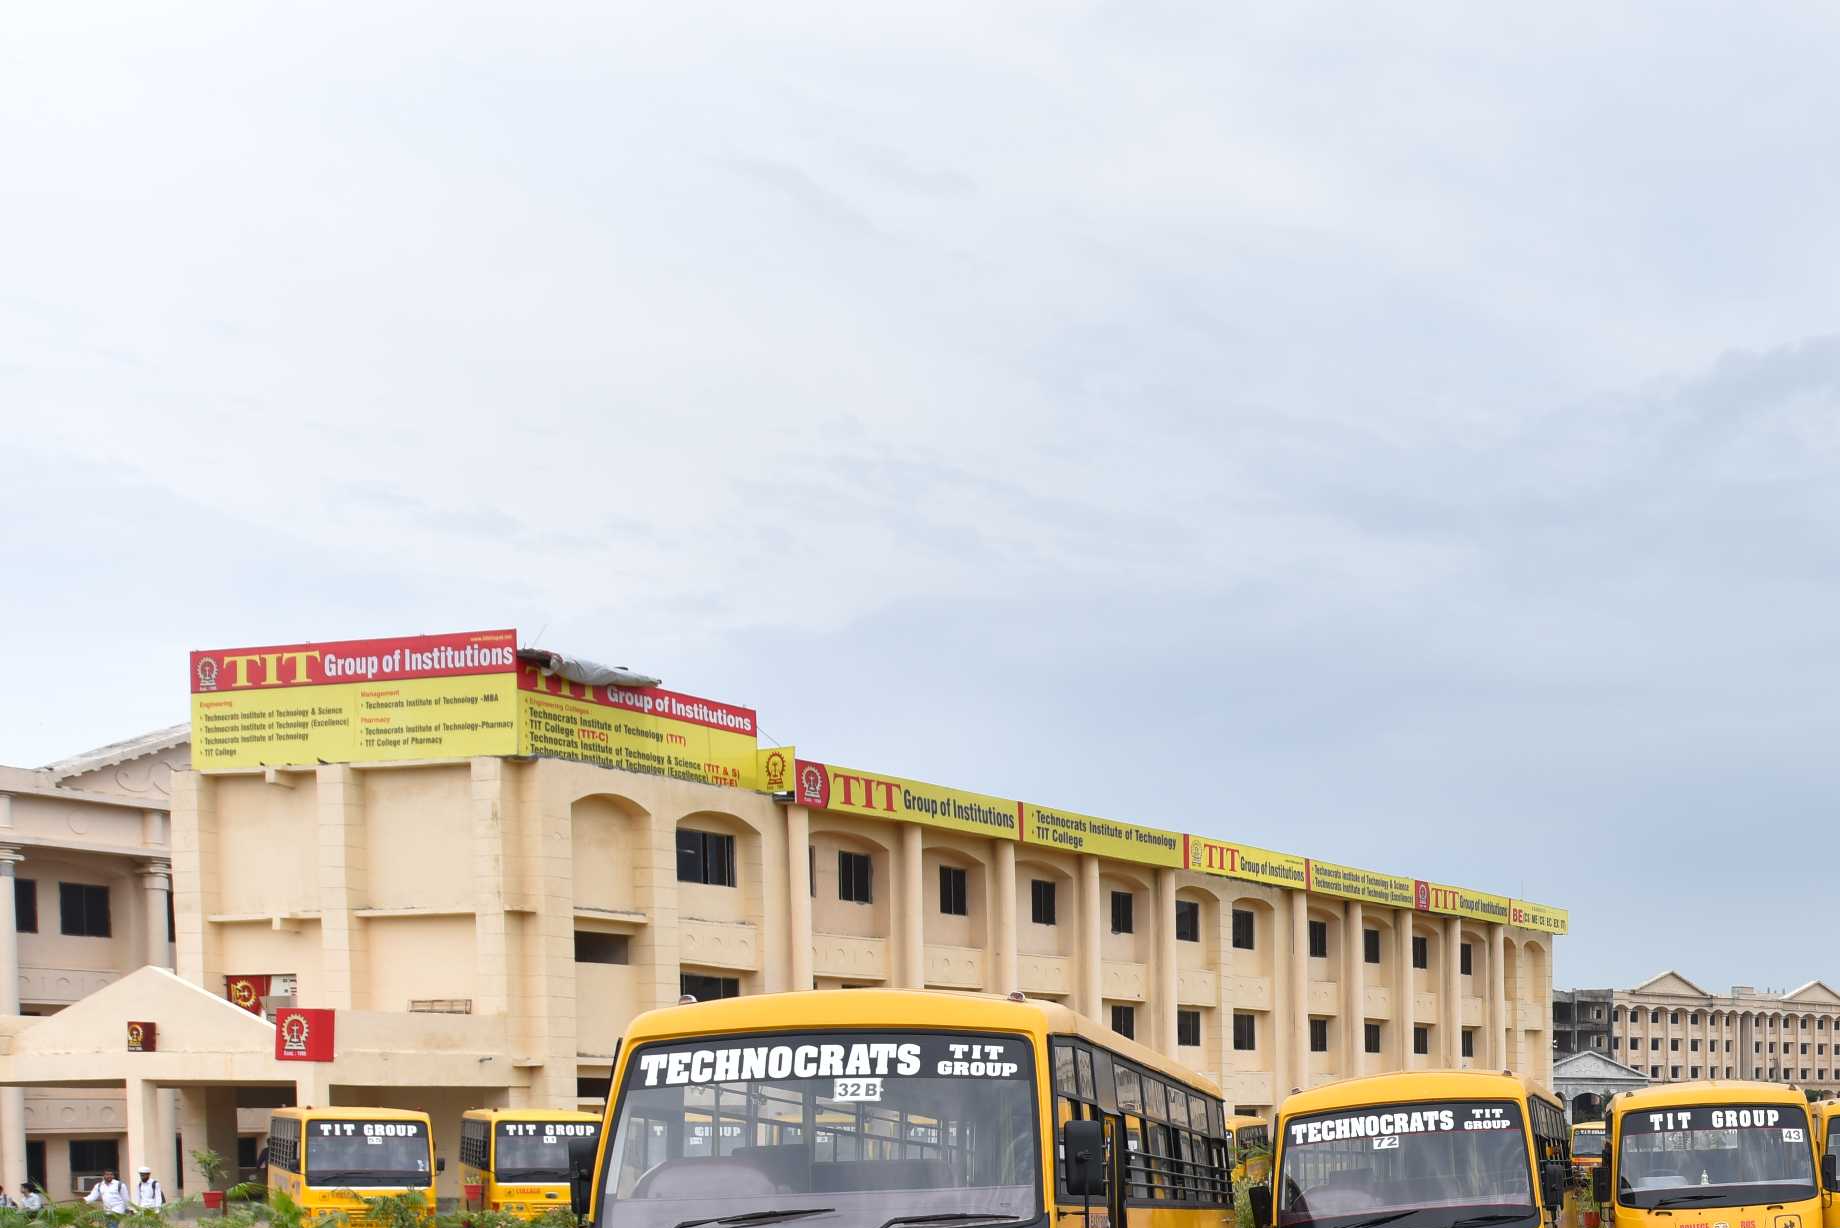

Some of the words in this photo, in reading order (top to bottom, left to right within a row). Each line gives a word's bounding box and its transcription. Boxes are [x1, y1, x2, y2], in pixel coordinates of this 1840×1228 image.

[224, 650, 321, 687] TIT
[324, 653, 378, 678] Group
[382, 650, 401, 672] of
[405, 643, 513, 671] Institutions
[365, 701, 404, 710] Technocrats
[406, 698, 432, 708] Institute
[435, 697, 441, 705] of
[443, 694, 478, 706] Technology
[607, 685, 653, 713] Group
[655, 696, 669, 713] of
[671, 698, 752, 731] Institutions
[204, 713, 239, 722] Technocrats
[241, 710, 266, 720] Institute
[268, 710, 274, 718] of
[276, 709, 309, 719] Technology
[311, 706, 316, 715] &
[318, 706, 342, 715] Science
[204, 726, 239, 734] Technocrats
[241, 723, 266, 731] Institute
[268, 722, 274, 730] of
[276, 720, 309, 730] Technology
[311, 718, 350, 729] (Excellence)
[365, 727, 403, 736] Technocrats
[406, 724, 432, 734] Institute
[434, 724, 441, 732] of
[529, 706, 578, 725] Technocrats
[580, 716, 612, 732] Institute
[614, 723, 621, 733] of
[624, 724, 664, 744] Technology
[665, 732, 687, 748] (TIT)
[529, 719, 541, 731] TIT
[544, 721, 575, 738] College
[204, 737, 239, 746] Technocrats
[241, 734, 266, 743] Institute
[268, 733, 274, 742] of
[276, 732, 309, 742] Technology
[365, 739, 375, 748] TIT
[377, 738, 400, 748] College
[403, 737, 409, 746] of
[410, 736, 442, 746] Pharmacy
[204, 749, 213, 757] TIT
[215, 748, 237, 757] College
[529, 731, 578, 749] Technocrats
[580, 740, 612, 754] Institute
[615, 746, 622, 756] of
[625, 747, 665, 766] Technology
[666, 755, 673, 766] &
[674, 756, 701, 771] Science
[530, 743, 578, 760] Technocrats
[626, 759, 665, 776] Technology
[833, 772, 902, 813] TIT
[903, 789, 938, 818] Group
[940, 800, 952, 816] of
[952, 801, 1014, 829] Institutions
[1036, 810, 1087, 833] Technocrats
[1089, 820, 1123, 839] Institute
[1125, 827, 1133, 841] of
[1135, 829, 1177, 850] Technology
[1036, 826, 1050, 840] TIT
[1052, 829, 1084, 848] College
[1204, 844, 1240, 873] TIT
[1240, 855, 1260, 877] Group
[1261, 859, 1268, 875] of
[1268, 860, 1305, 882] Institutions
[1431, 887, 1459, 911] TIT
[1460, 895, 1474, 913] Group
[1475, 899, 1480, 911] of
[1480, 900, 1507, 917] Institutions
[1513, 908, 1523, 923] BE
[948, 1043, 1004, 1059] TIT
[639, 1042, 921, 1087] TECHNOCRATS
[937, 1060, 1018, 1077] GROUP
[1471, 1108, 1504, 1119] TIT
[1650, 1111, 1691, 1131] TIT
[1711, 1110, 1779, 1128] GROUP
[320, 1124, 355, 1136] TIT
[363, 1124, 418, 1136] GROUP
[505, 1124, 536, 1136] TIT
[545, 1125, 595, 1136] GROUP
[1291, 1110, 1454, 1145] TECHNOCRATS
[1464, 1119, 1510, 1130] GROUP
[1376, 1136, 1397, 1148] 72
[1785, 1130, 1801, 1140] 43
